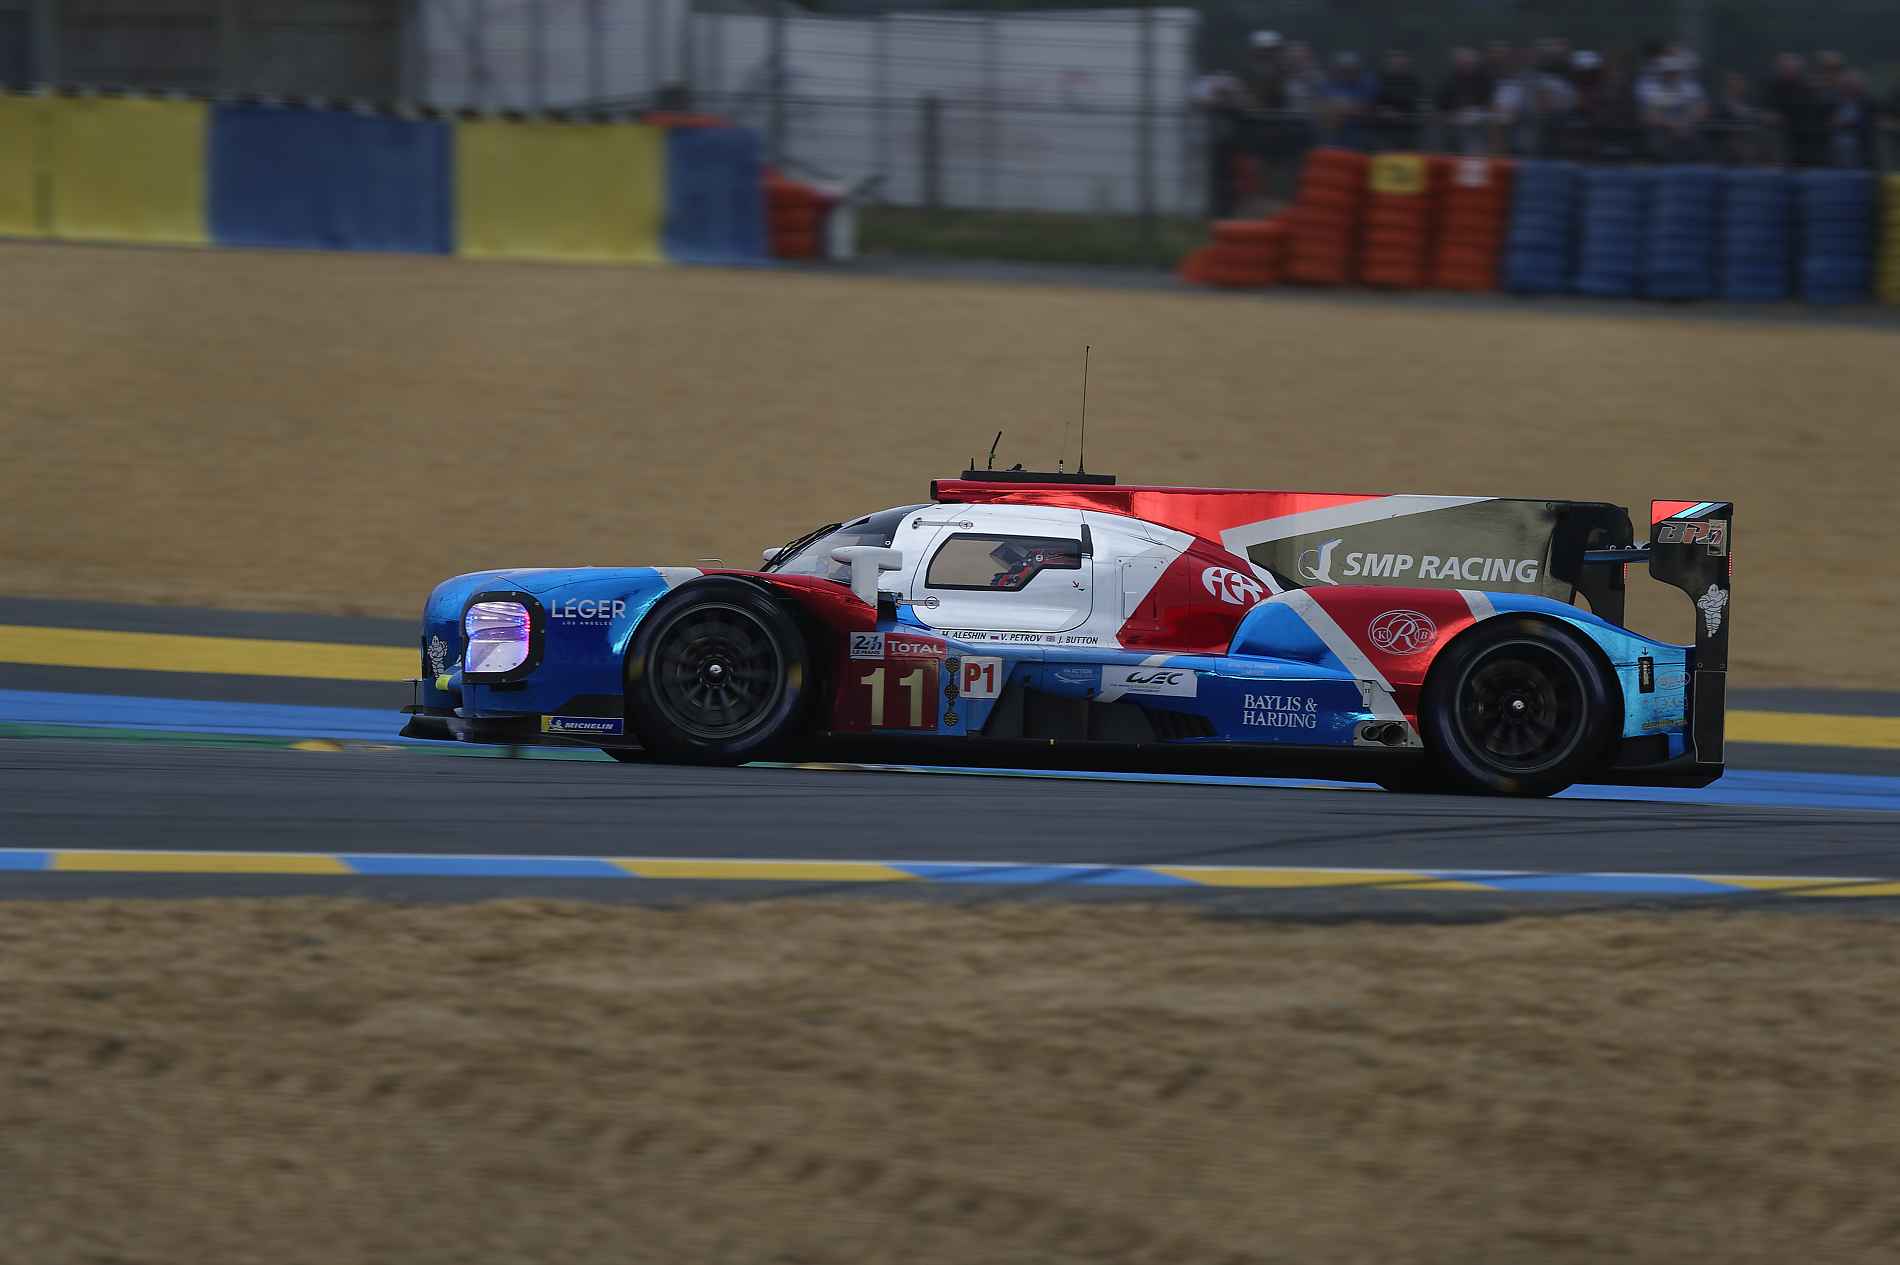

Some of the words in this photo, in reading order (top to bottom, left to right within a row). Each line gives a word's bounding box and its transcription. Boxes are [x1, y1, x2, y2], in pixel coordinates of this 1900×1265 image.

[1343, 552, 1414, 577] SMP
[1418, 555, 1539, 583] RACING
[551, 598, 626, 619] LÉGER
[952, 631, 987, 640] ALESHIN
[1010, 634, 1042, 642] PETROV
[1057, 636, 1065, 644] J.
[1066, 636, 1098, 645] BUTTON
[888, 640, 943, 654] TOTAL
[963, 663, 995, 693] P1
[1126, 671, 1183, 685] WEC
[861, 667, 924, 727] 11
[1243, 694, 1301, 711] BAYLIS
[1305, 698, 1318, 712] &
[1243, 711, 1317, 728] HARDING
